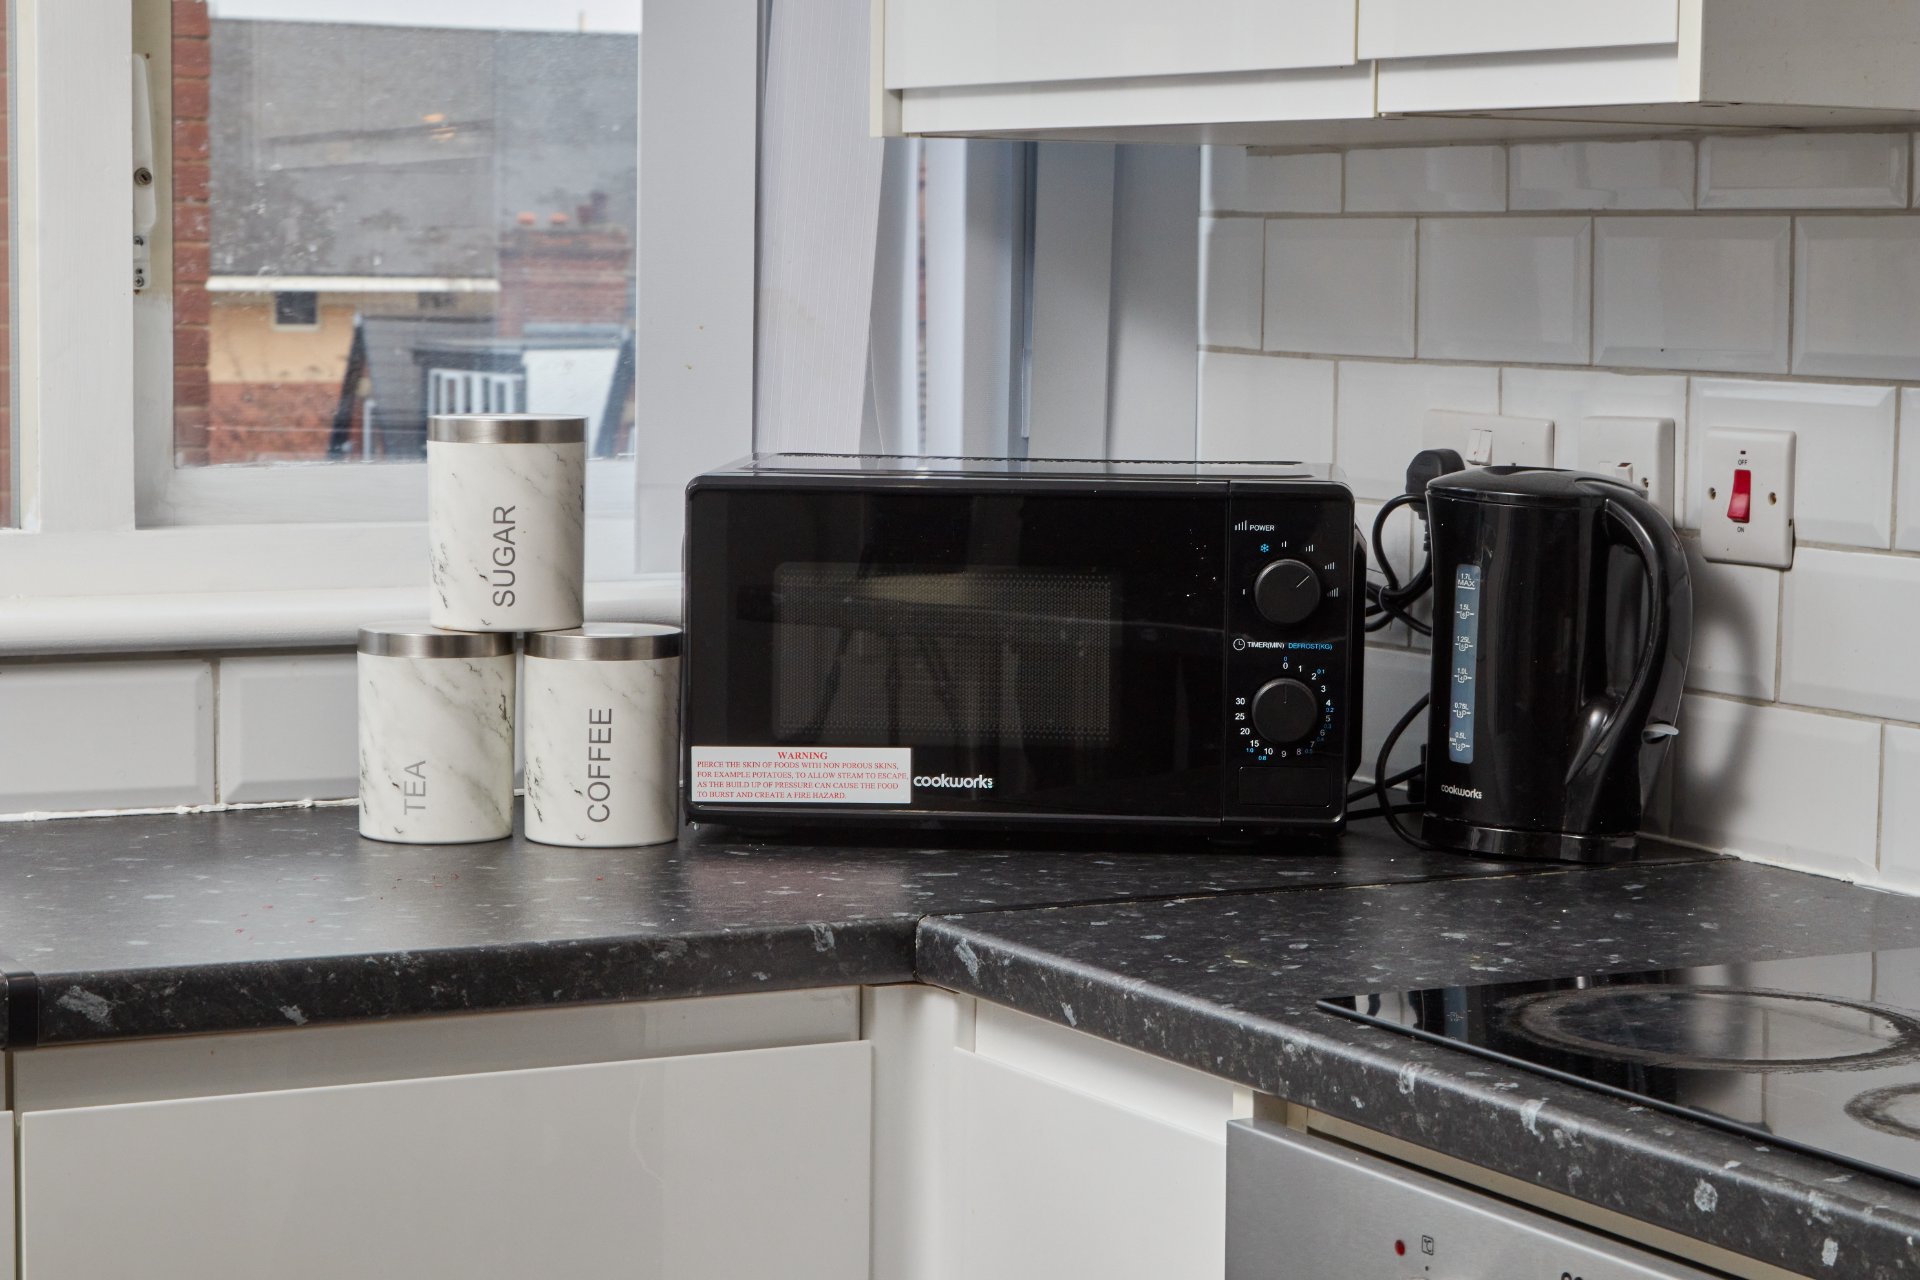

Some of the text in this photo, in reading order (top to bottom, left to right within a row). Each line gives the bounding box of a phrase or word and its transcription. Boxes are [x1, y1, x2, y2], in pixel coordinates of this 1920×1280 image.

[492, 505, 516, 607] SUGAR
[1247, 641, 1284, 649] TIMER(MIN)
[778, 752, 828, 760] WARNING
[587, 708, 612, 823] COFFEE
[875, 762, 898, 770] SKINS,
[404, 760, 426, 815] TEA
[913, 774, 993, 789] cookworks
[1441, 785, 1482, 799] cookworks
